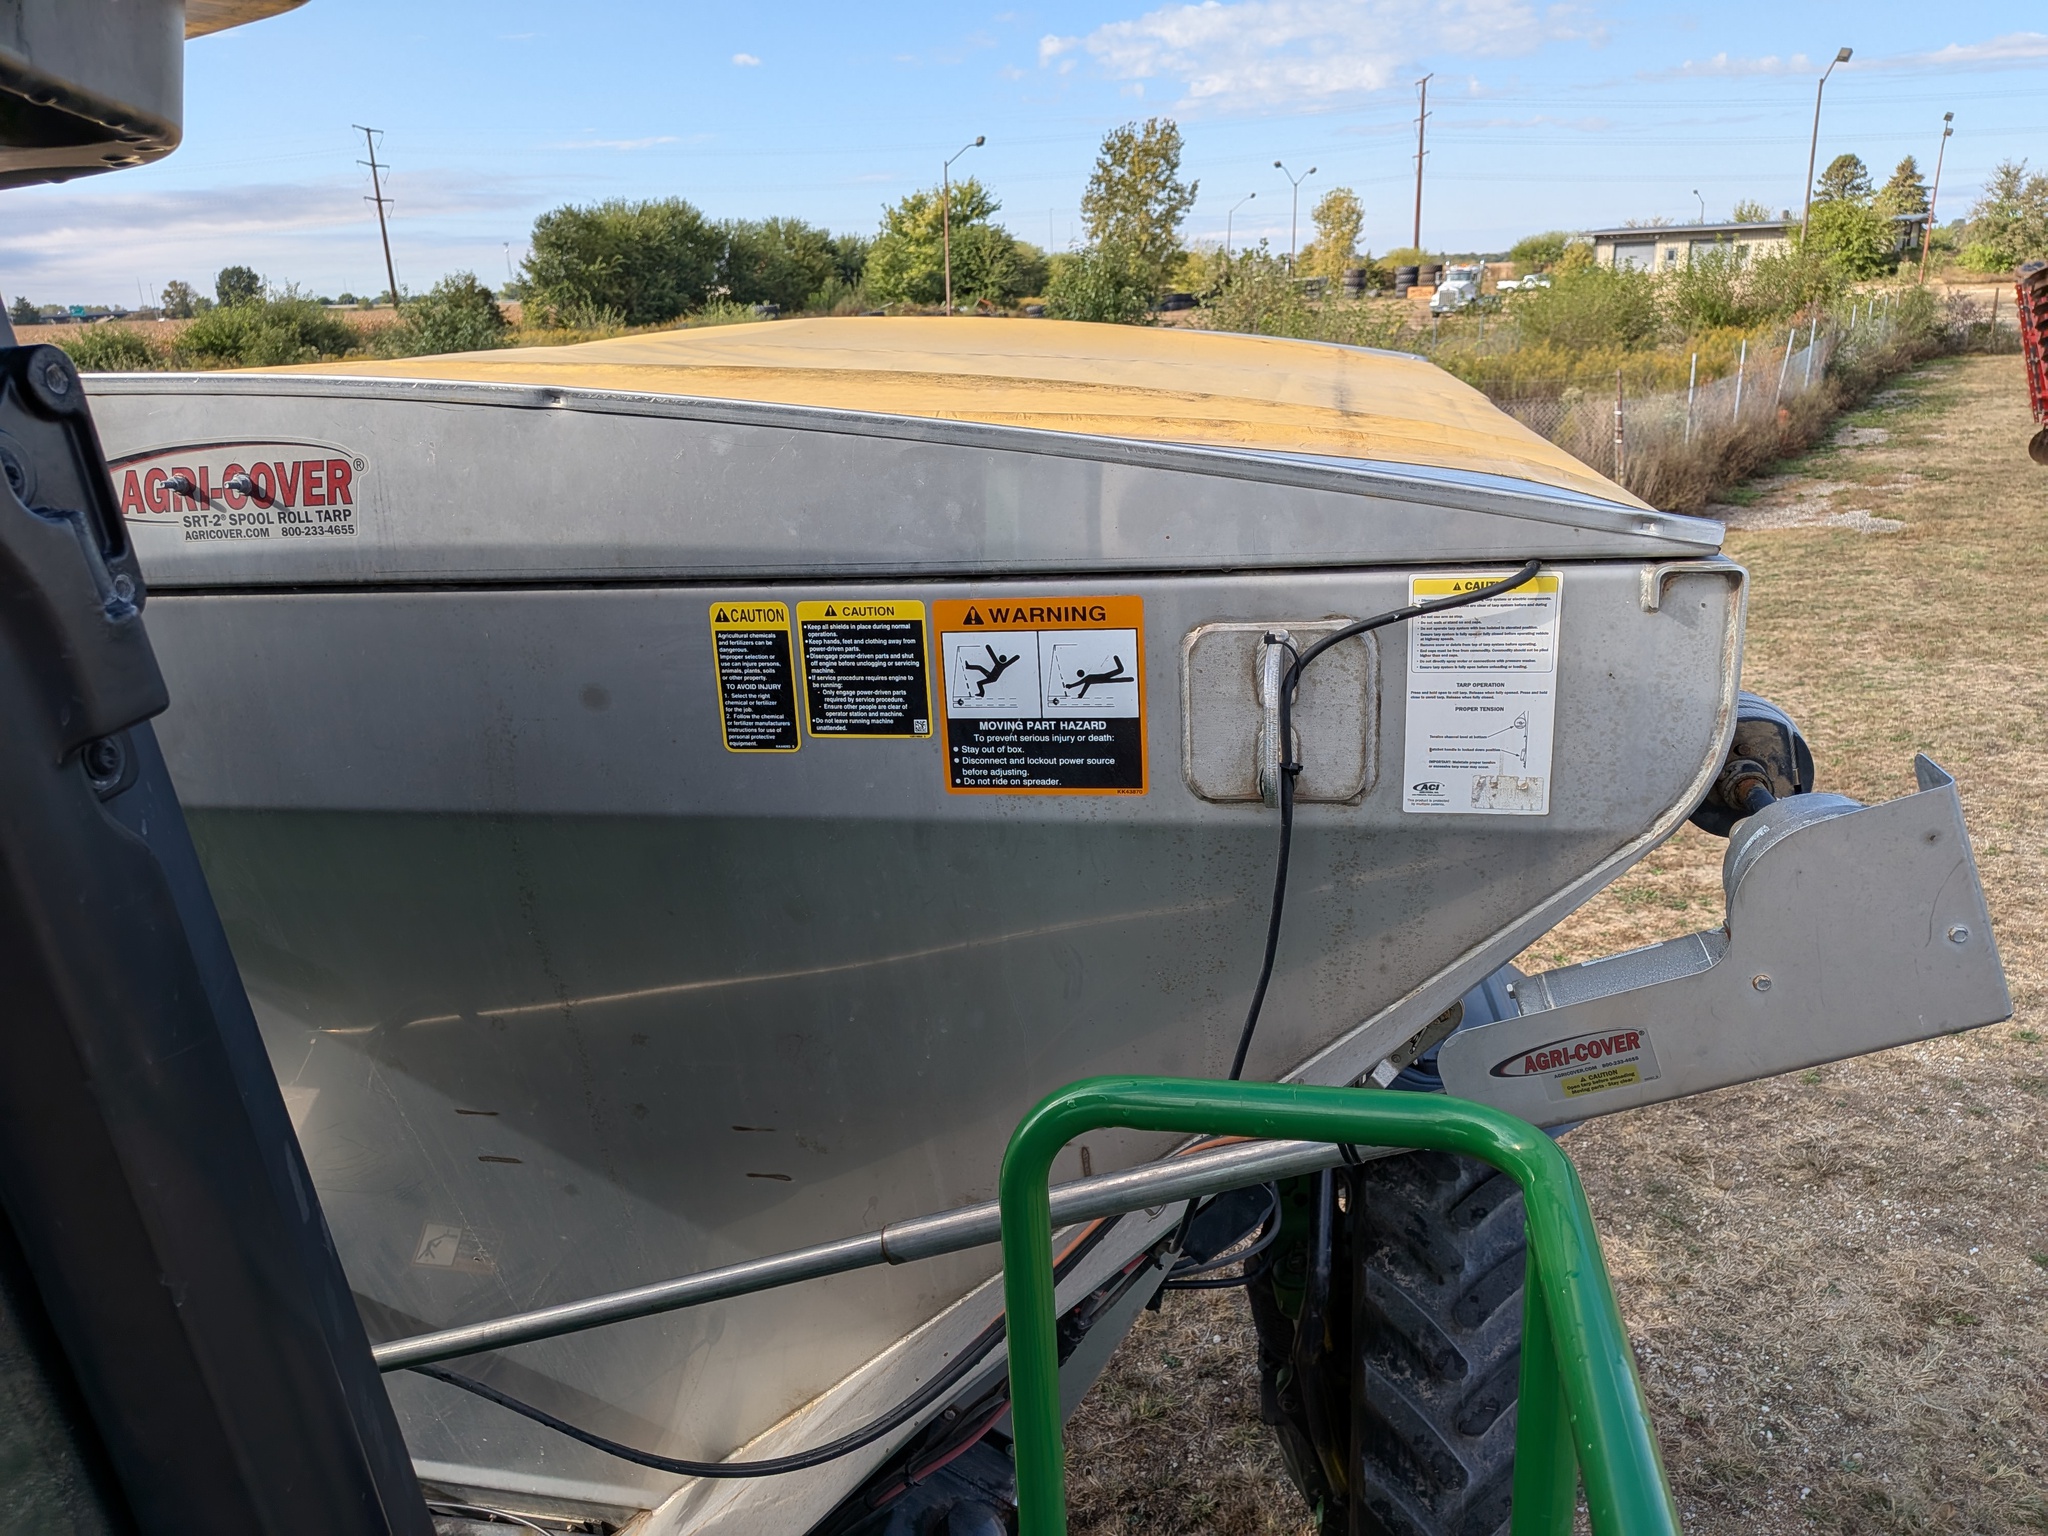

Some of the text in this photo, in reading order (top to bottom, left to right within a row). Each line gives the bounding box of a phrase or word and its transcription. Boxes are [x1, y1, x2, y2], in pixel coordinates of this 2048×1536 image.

[229, 512, 274, 526] SPOOL
[278, 510, 313, 524] ROLL
[316, 509, 352, 523] TARP
[184, 524, 355, 541] AGRICOVER.COM 800-233-4655
[730, 608, 785, 622] CAUTION
[842, 607, 895, 616] CAUTION
[988, 606, 1107, 623] WARNING
[979, 721, 1107, 731] MOVING PART HAZARD
[973, 734, 984, 742] To
[986, 734, 1017, 745] prevent
[1020, 734, 1050, 742] serious
[1052, 734, 1075, 744] injury
[1088, 734, 1115, 742] death:
[961, 745, 1024, 756] Stay out of box.
[962, 757, 1007, 765] Disconnect
[1010, 757, 1025, 765] and
[1027, 757, 1057, 765] lockout
[1059, 758, 1084, 766] power
[962, 768, 1029, 778] before adjusting.
[964, 778, 975, 786] Do
[977, 778, 991, 786] not
[992, 778, 1008, 786] ride
[1023, 778, 1062, 787] spreader.
[1588, 1069, 1618, 1080] CAUTION
